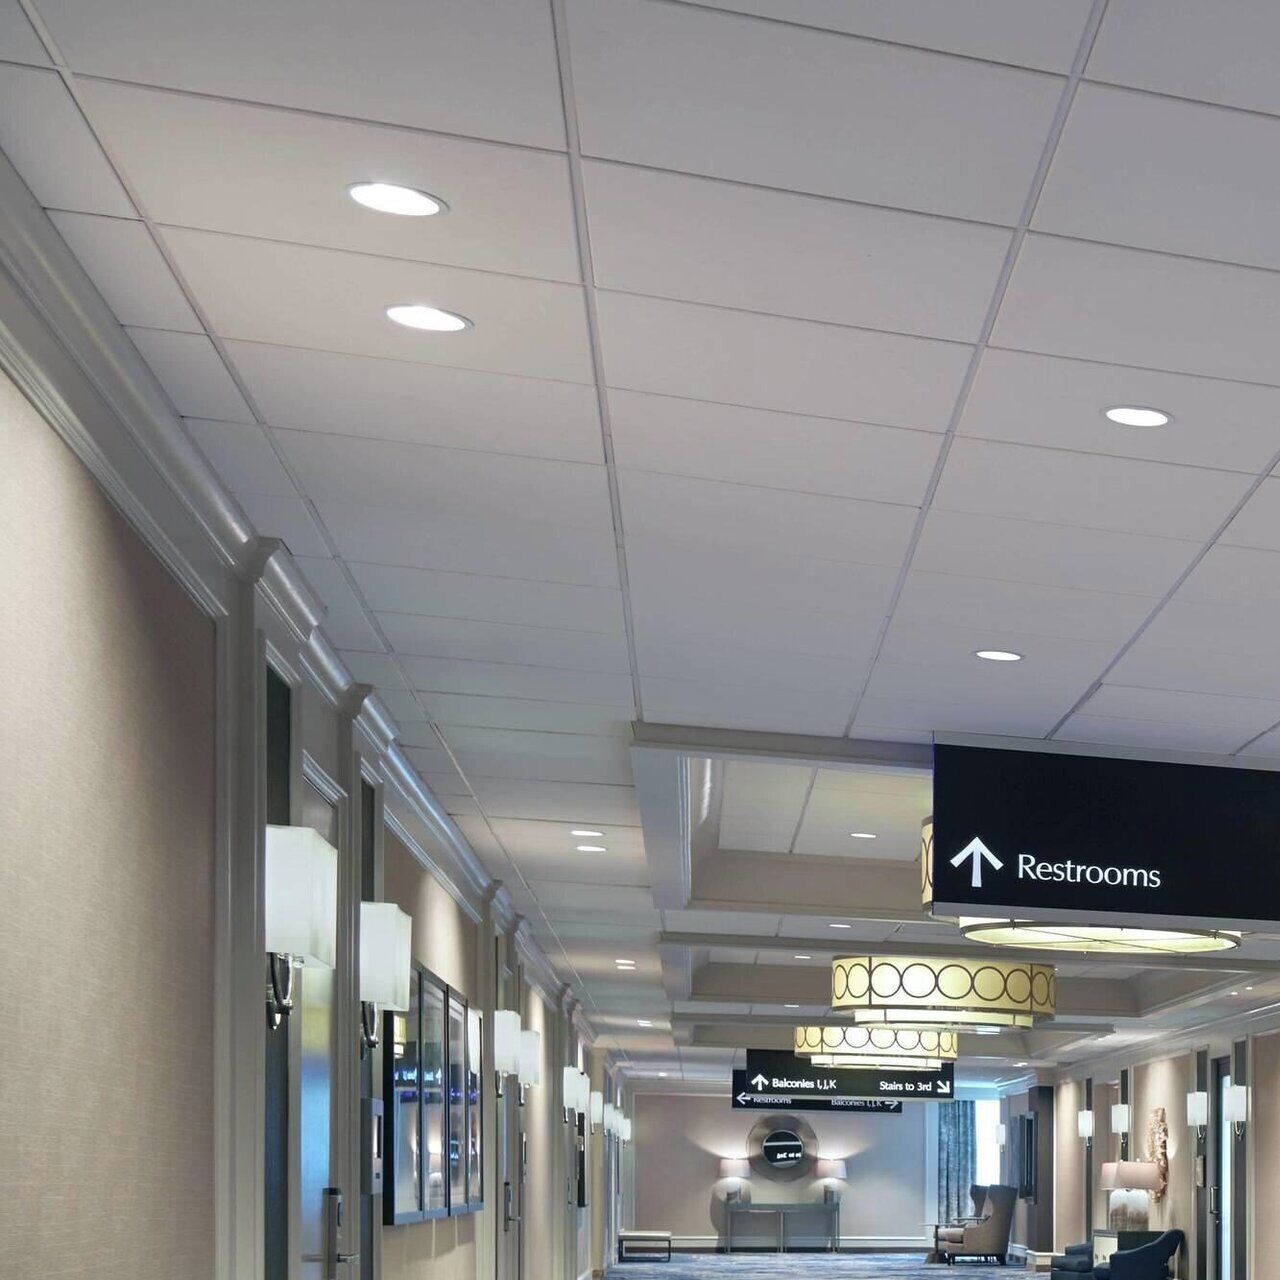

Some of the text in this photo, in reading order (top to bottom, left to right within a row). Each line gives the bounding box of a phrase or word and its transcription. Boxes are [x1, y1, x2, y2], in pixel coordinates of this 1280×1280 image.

[1018, 854, 1161, 887] Restrooms
[772, 1078, 814, 1089] Balconies
[880, 1081, 932, 1092] Stairs to 3rd
